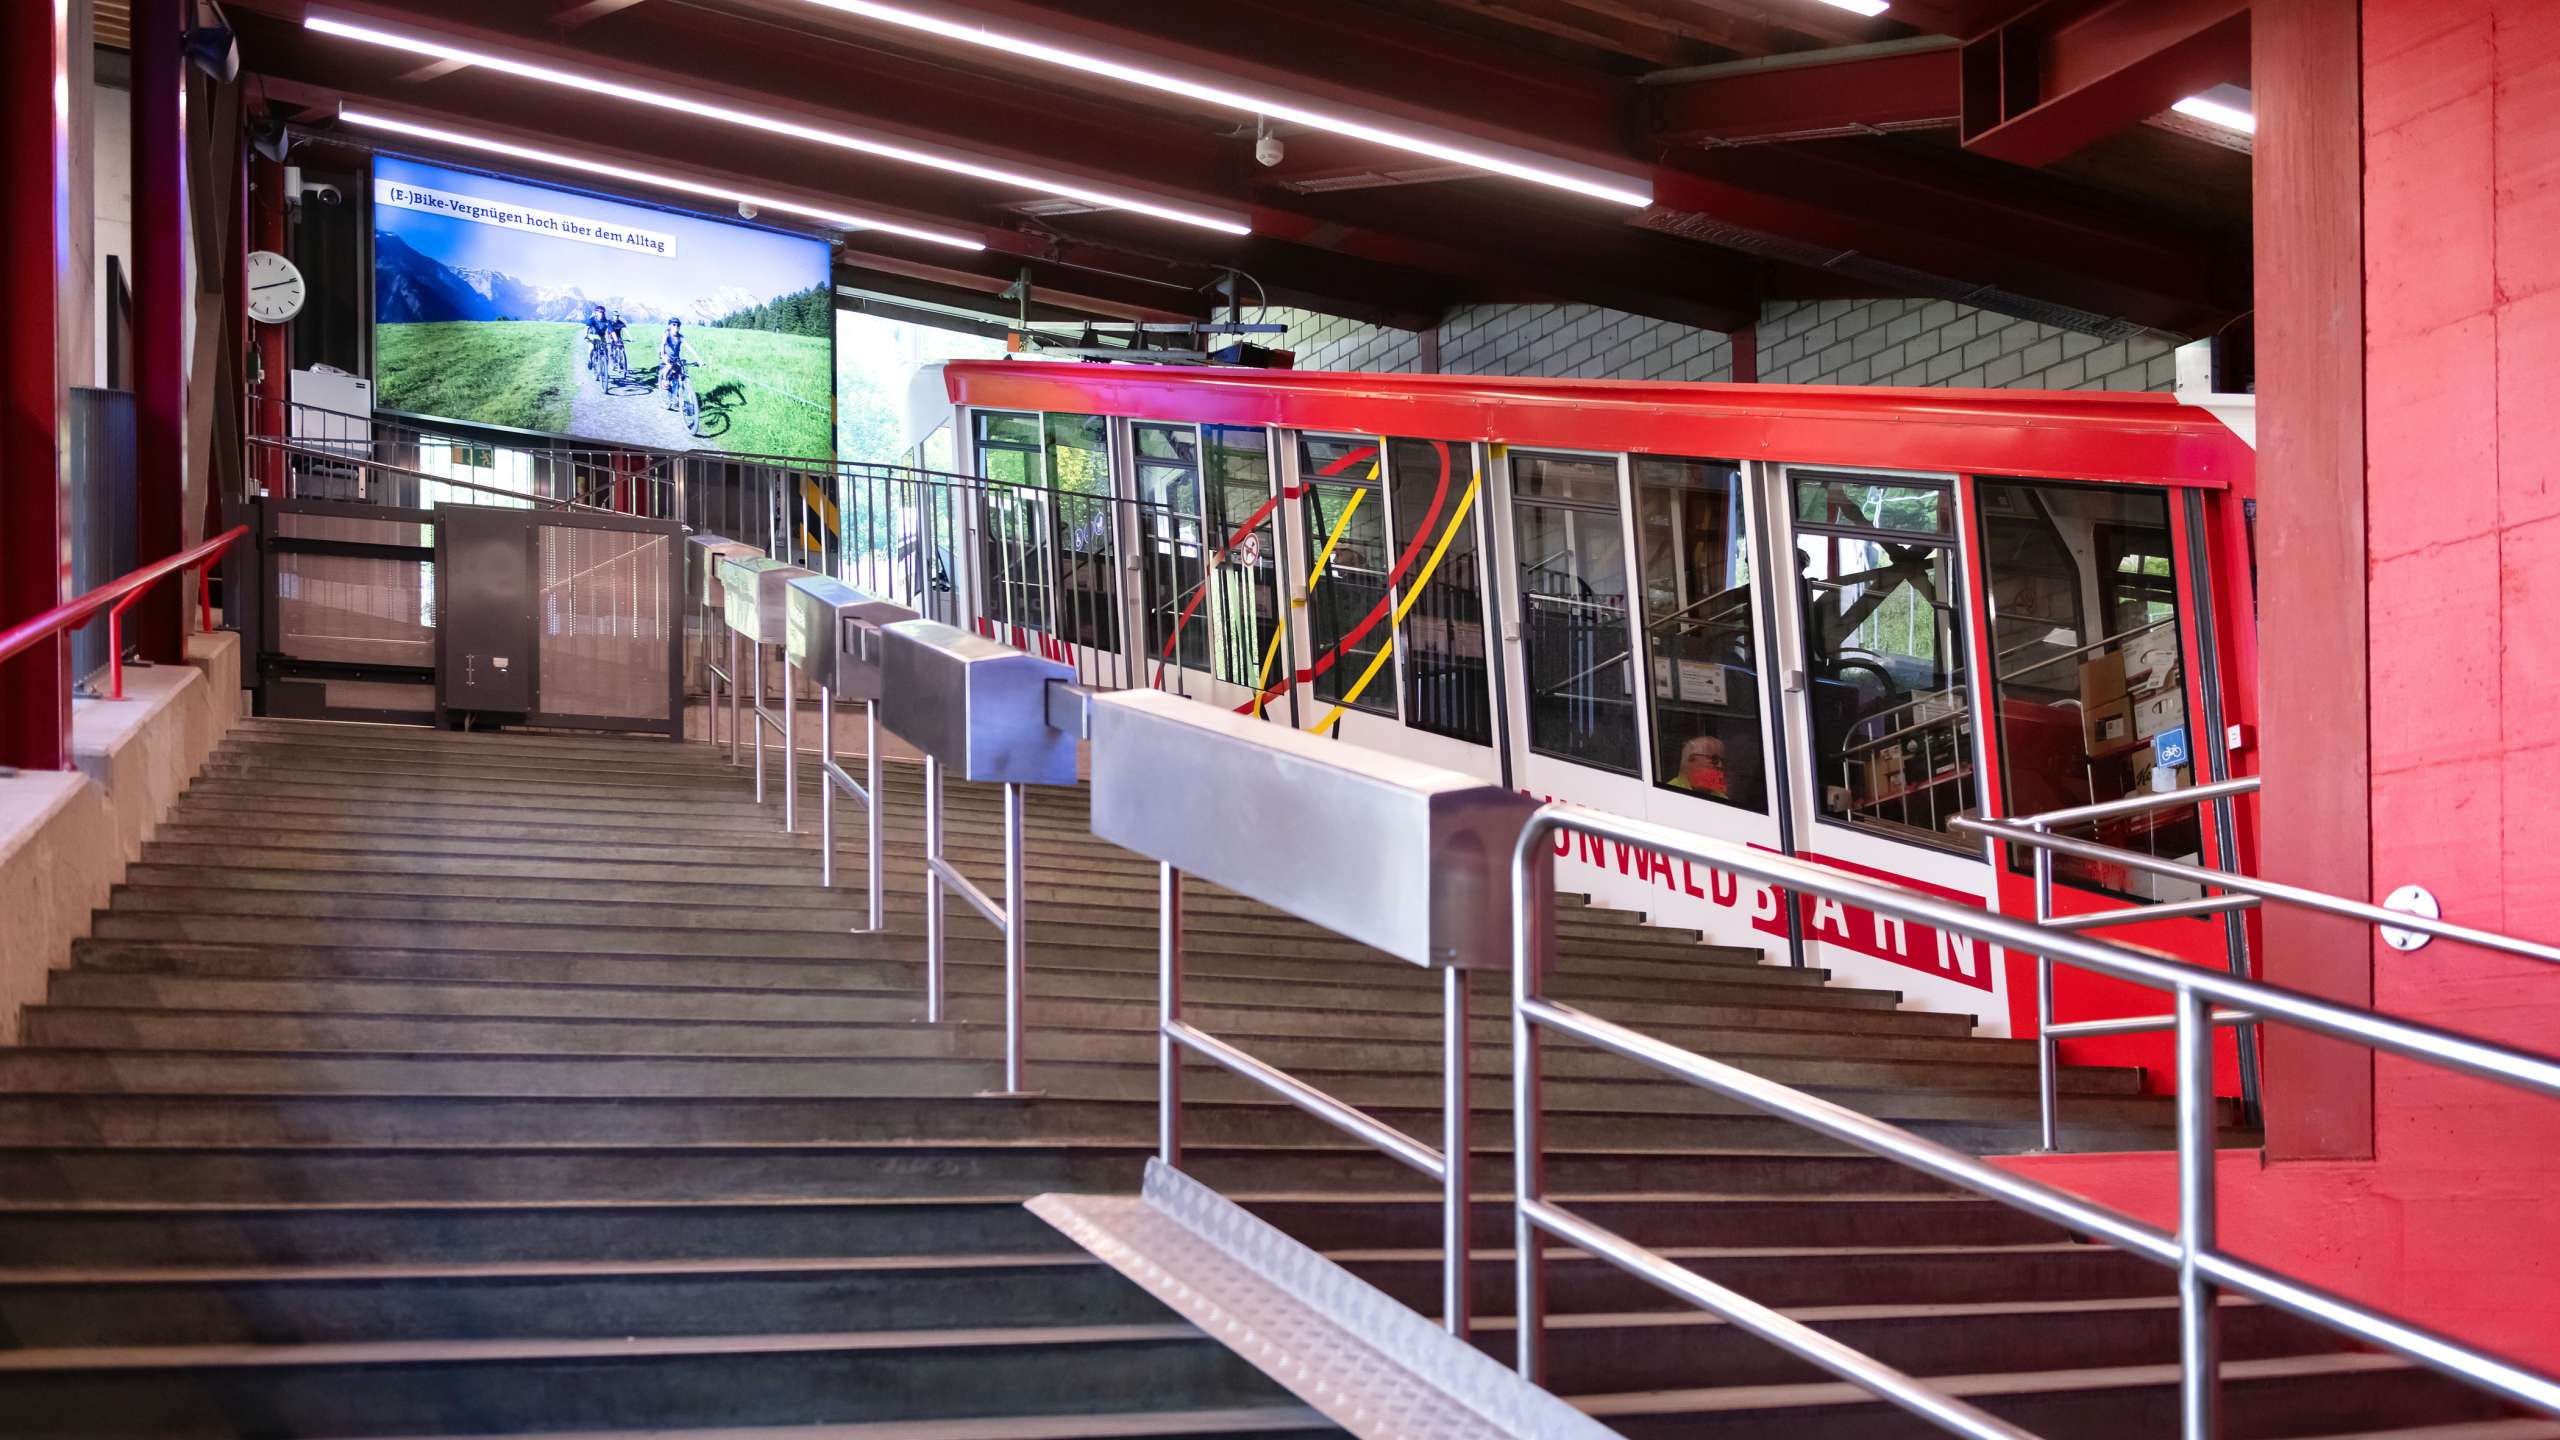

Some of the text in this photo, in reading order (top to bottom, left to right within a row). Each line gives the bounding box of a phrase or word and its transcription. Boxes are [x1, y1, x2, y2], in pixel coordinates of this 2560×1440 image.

[389, 187, 665, 253] (E-)Bike-Vergnügen hoch über dem Alltag
